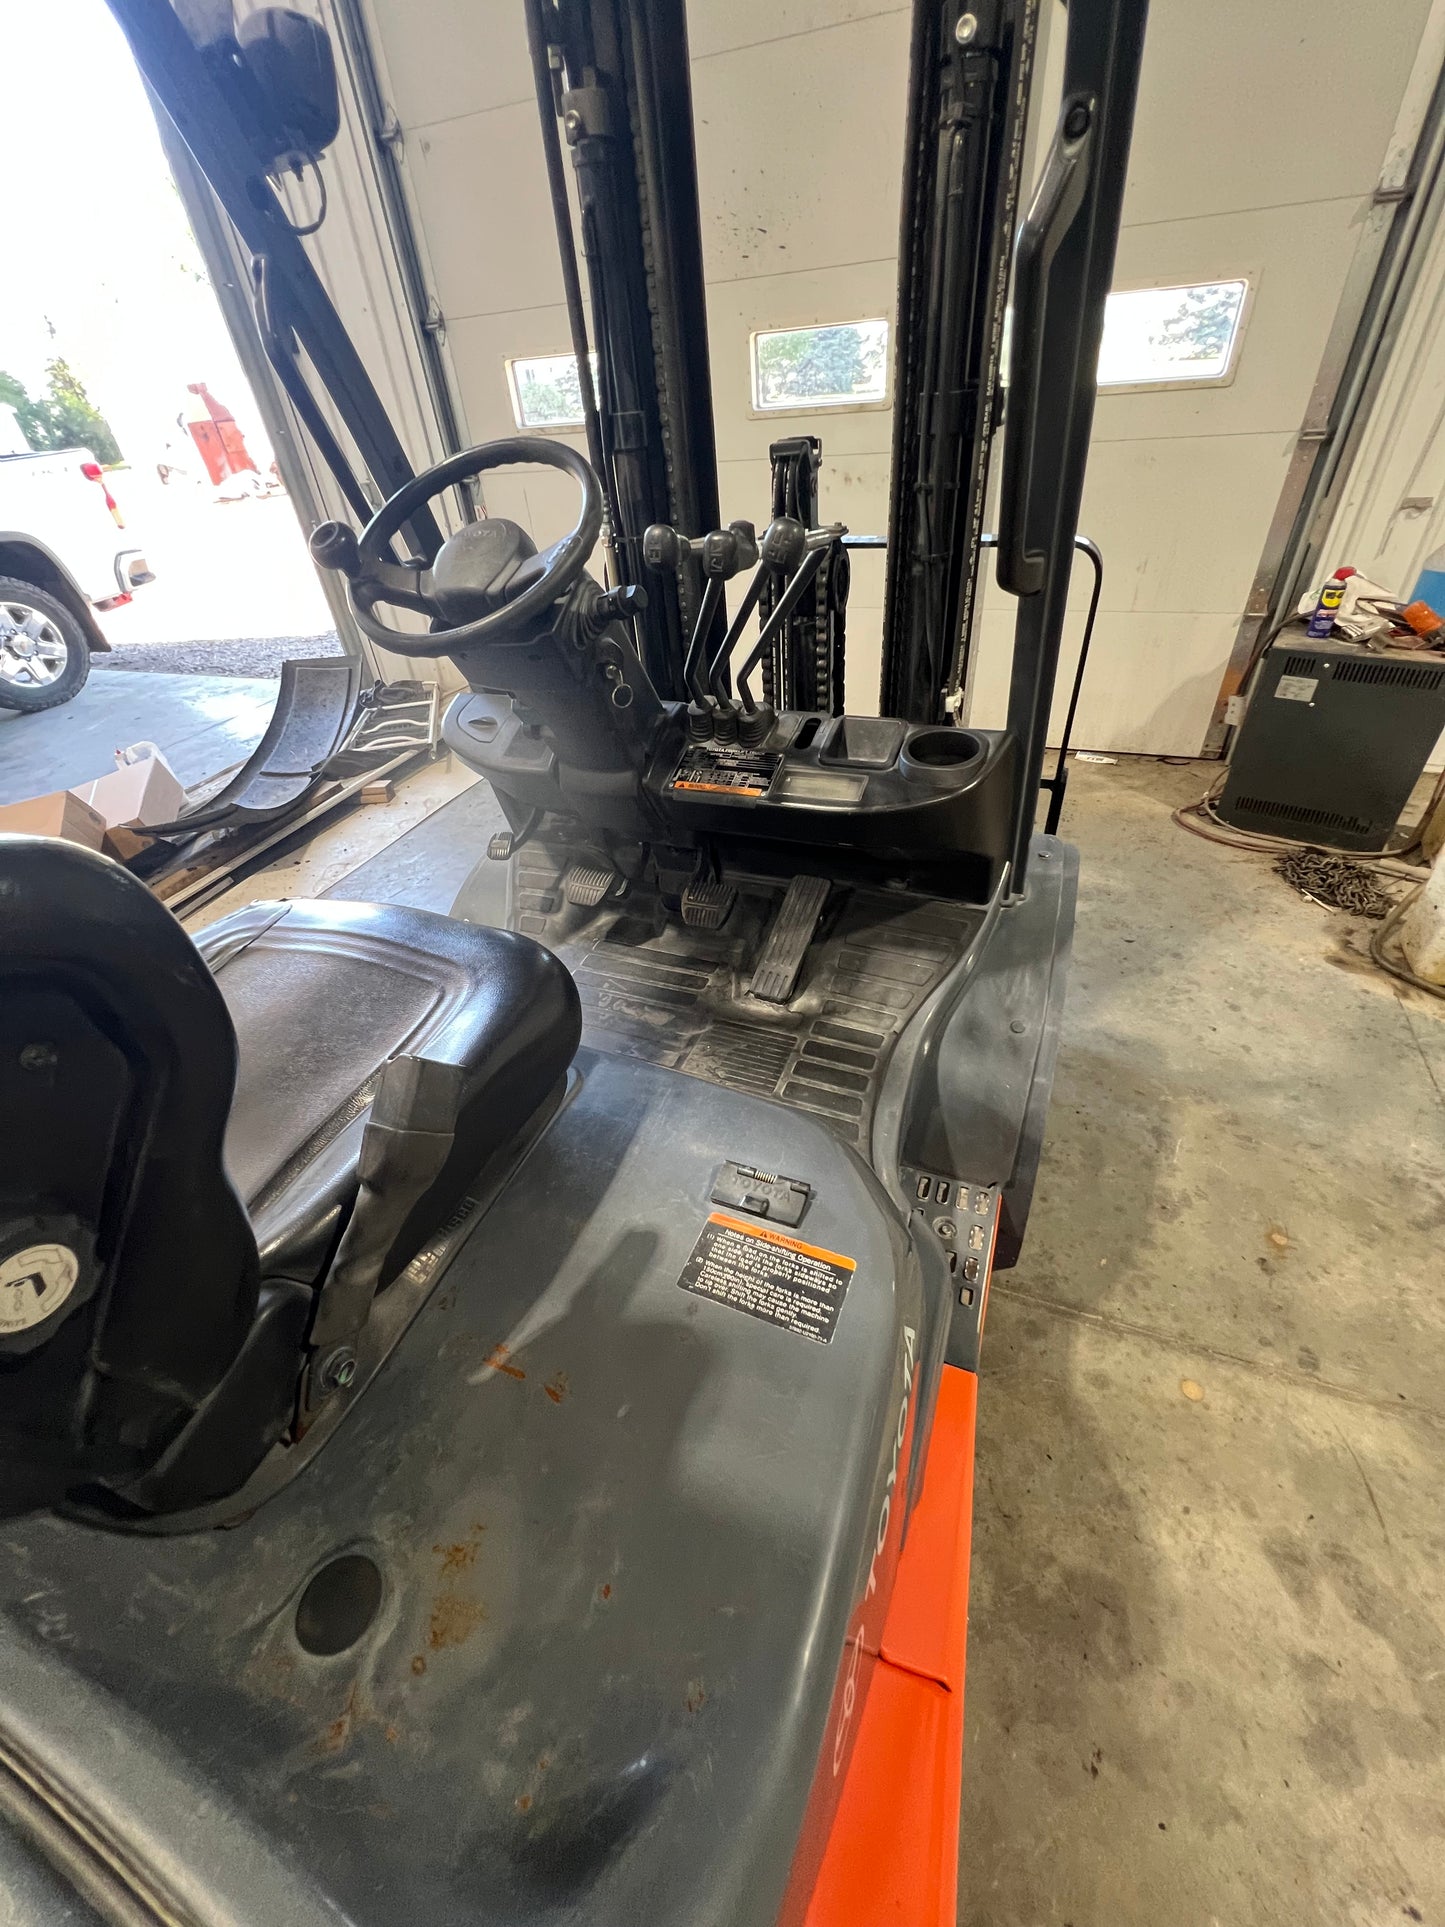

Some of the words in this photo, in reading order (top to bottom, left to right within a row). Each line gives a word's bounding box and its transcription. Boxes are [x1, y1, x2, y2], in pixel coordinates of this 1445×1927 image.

[731, 1177, 790, 1202] TOYOTA
[716, 1237, 734, 1246] When
[782, 1260, 799, 1269] forks
[724, 1229, 744, 1239] Notes
[797, 1254, 831, 1270] Operation
[769, 1234, 802, 1248] WARNING
[708, 1252, 736, 1265] between
[699, 1270, 728, 1284] Careless
[752, 1291, 766, 1300] may
[767, 1297, 787, 1307] cause
[800, 1309, 829, 1323] machine
[704, 1260, 722, 1270] When
[775, 1286, 792, 1296] forks
[800, 1296, 818, 1305] more
[818, 1302, 834, 1312] than
[730, 1288, 746, 1297] Shift
[746, 1294, 757, 1302] the
[758, 1299, 775, 1309] forks
[769, 1291, 784, 1299] care
[792, 1277, 830, 1293] positioned
[712, 1288, 726, 1296] shift
[738, 1298, 755, 1309] forks
[756, 1305, 773, 1315] more
[774, 1312, 789, 1321] than
[865, 1326, 915, 1601] TOYOTA
